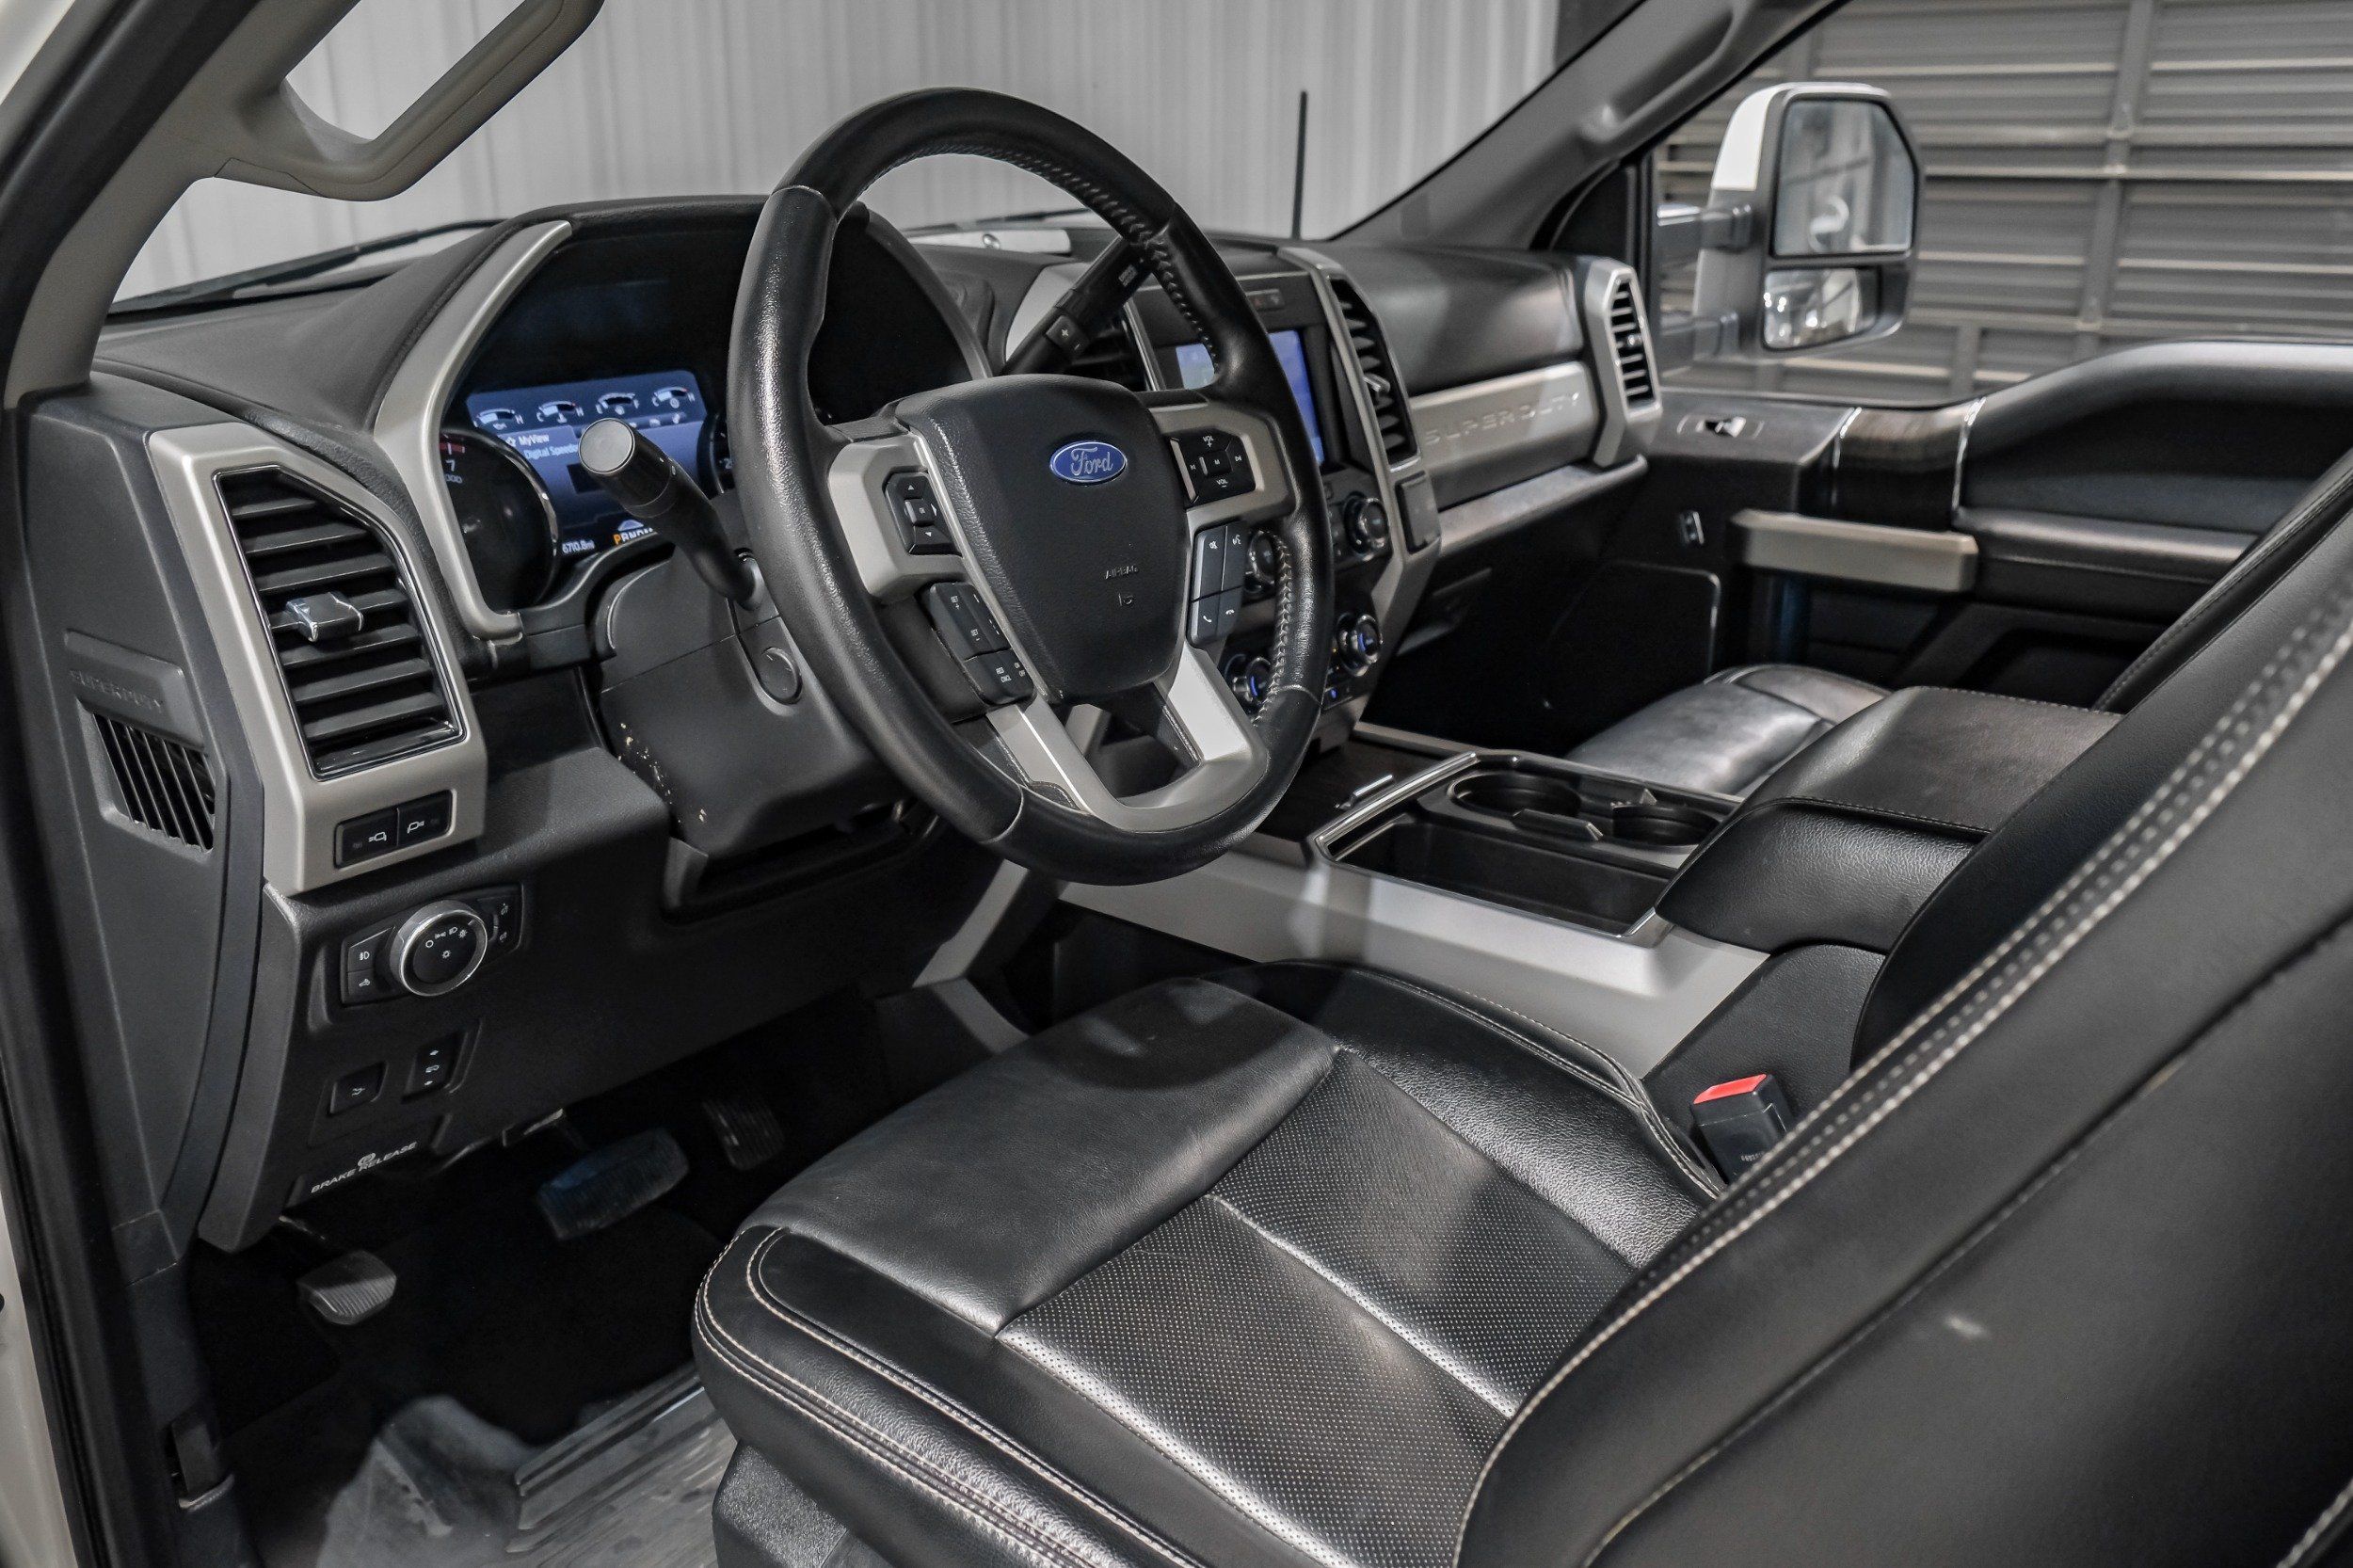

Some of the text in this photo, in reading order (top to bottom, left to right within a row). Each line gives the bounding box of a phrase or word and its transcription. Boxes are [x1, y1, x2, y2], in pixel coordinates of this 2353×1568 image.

[518, 434, 550, 446] MyView
[523, 446, 550, 460] Digital
[444, 458, 455, 472] 7
[1070, 446, 1113, 476] Ford
[311, 1141, 418, 1193] BRAKE RELEASE
